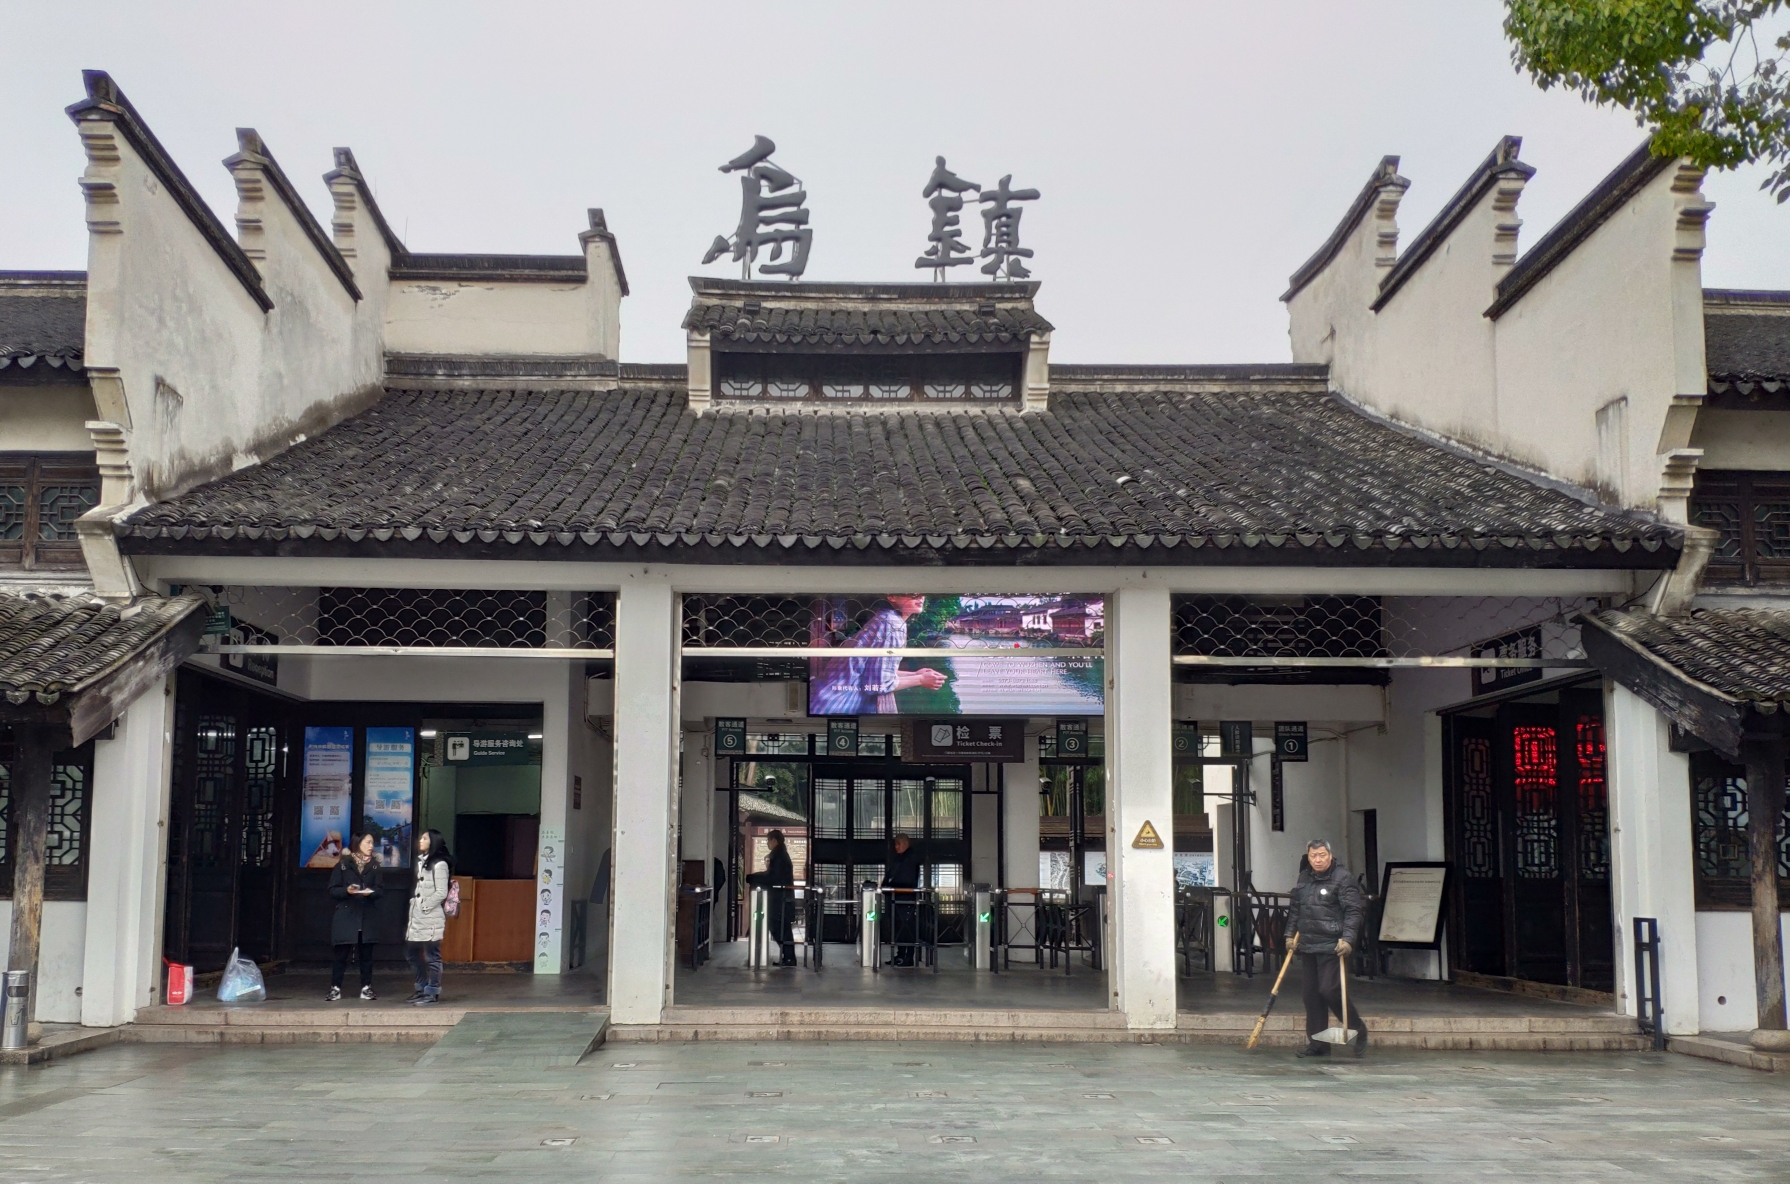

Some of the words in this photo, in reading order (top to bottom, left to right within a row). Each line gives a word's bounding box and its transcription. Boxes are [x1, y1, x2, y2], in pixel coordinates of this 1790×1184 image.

[1500, 667, 1517, 680] Ticket
[718, 720, 745, 728] 散客通道
[1060, 723, 1086, 731] 散客通道
[473, 739, 524, 748] 导游服务咨询处
